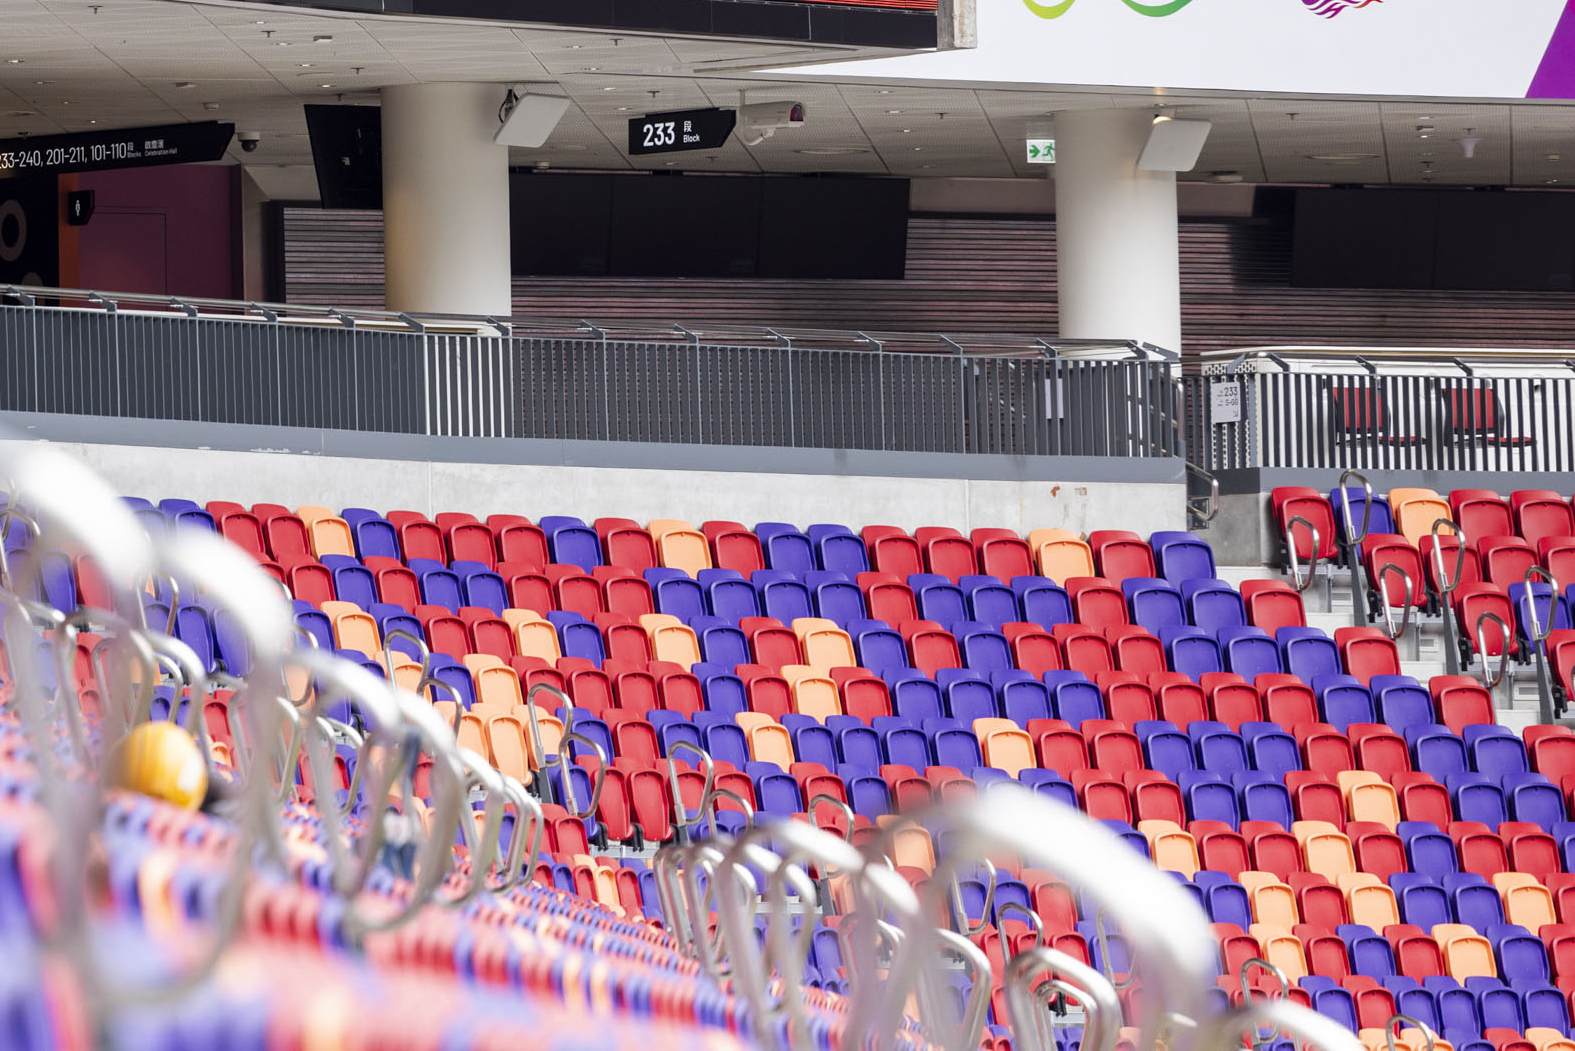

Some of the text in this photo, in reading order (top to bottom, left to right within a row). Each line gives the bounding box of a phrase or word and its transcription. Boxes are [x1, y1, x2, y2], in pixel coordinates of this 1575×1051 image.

[683, 120, 692, 132] 段
[643, 121, 675, 147] 233
[683, 133, 700, 143] Block
[46, 146, 88, 165] 201-211,
[90, 142, 127, 162] 101-110
[1224, 386, 1239, 397] 233
